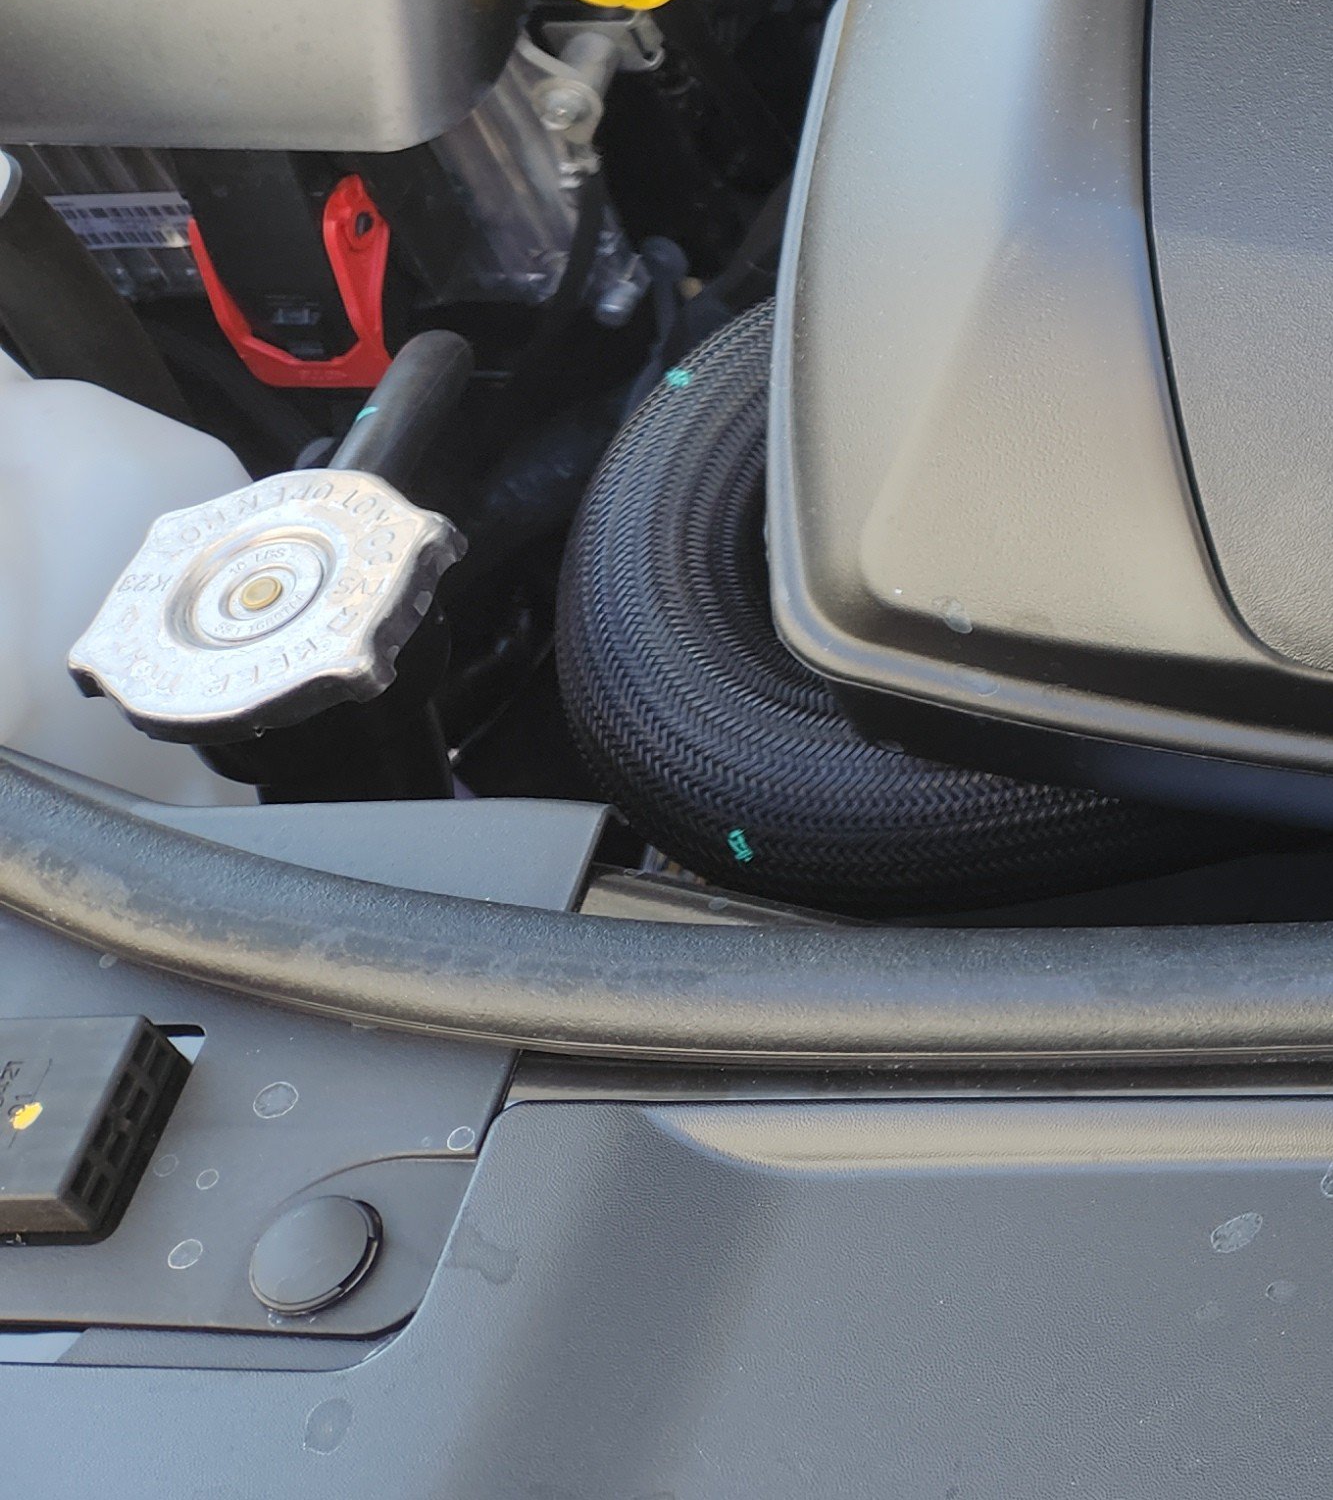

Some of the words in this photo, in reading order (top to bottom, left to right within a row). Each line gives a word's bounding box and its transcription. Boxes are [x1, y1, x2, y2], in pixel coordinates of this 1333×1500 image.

[117, 572, 174, 594] K23
[333, 575, 390, 598] TVS
[206, 634, 323, 697] KEEP
